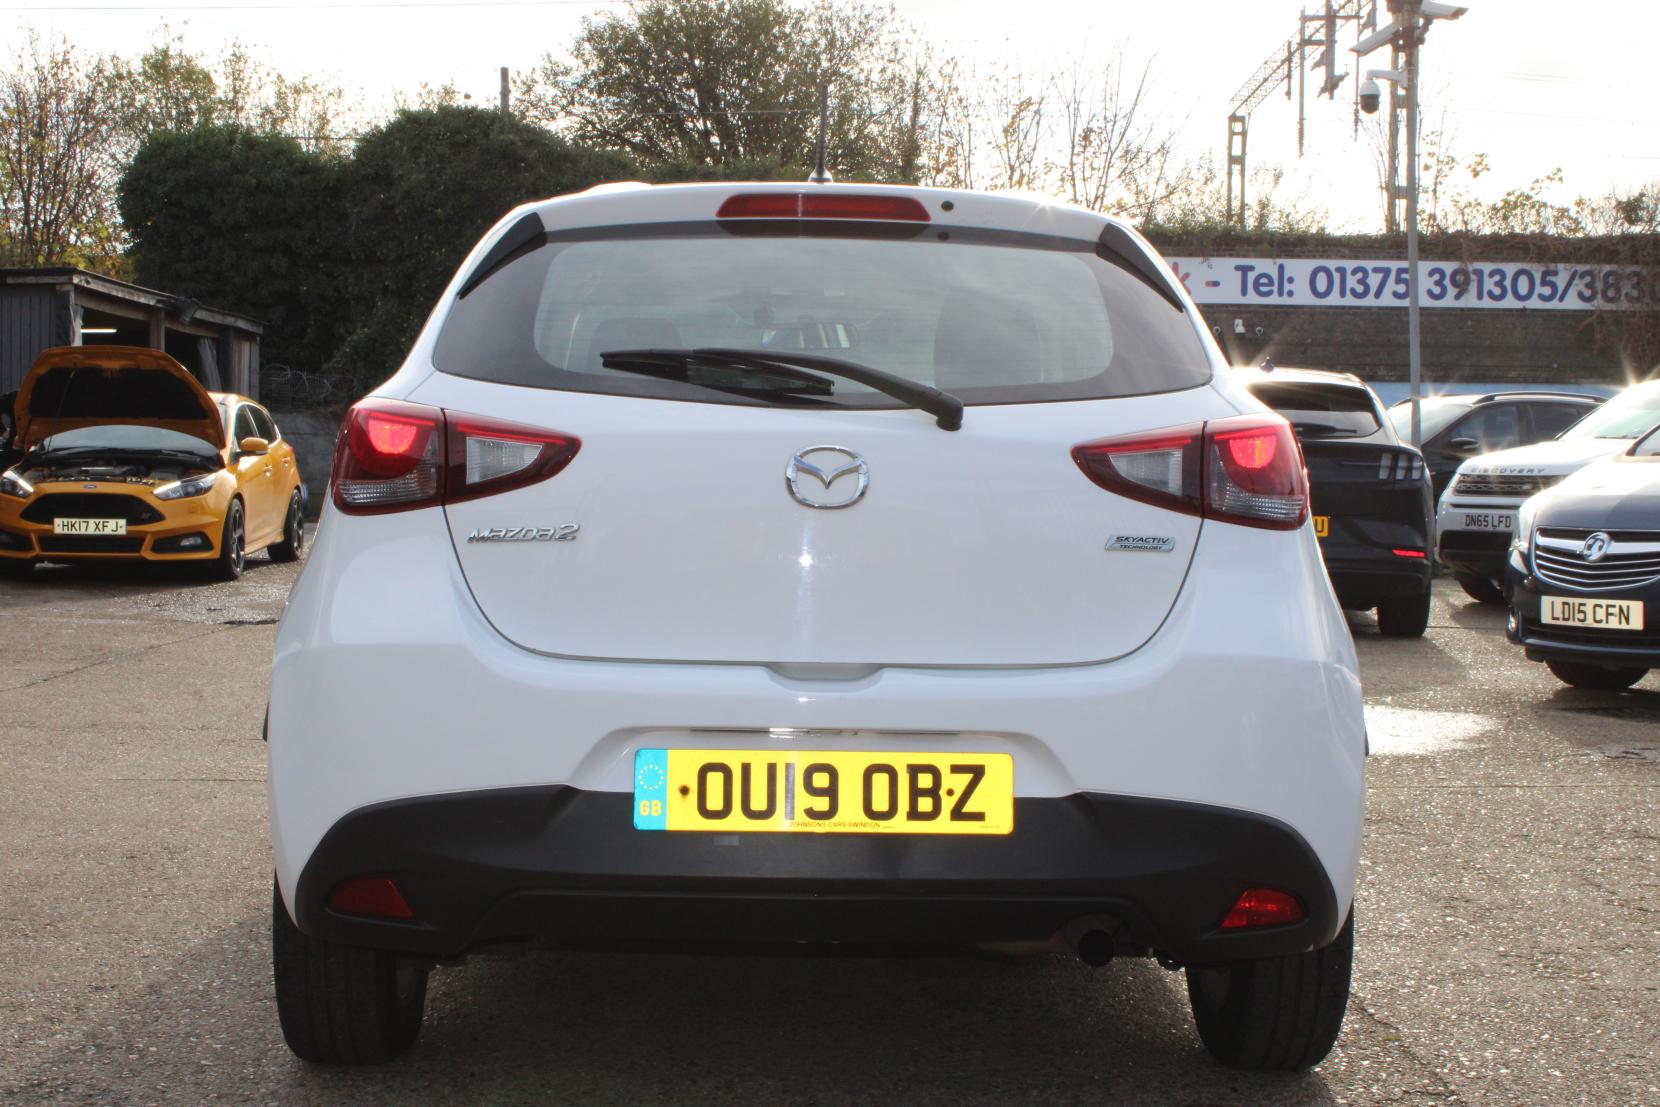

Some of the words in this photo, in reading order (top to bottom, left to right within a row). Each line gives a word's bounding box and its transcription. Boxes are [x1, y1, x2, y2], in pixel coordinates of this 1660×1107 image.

[1233, 263, 1295, 298] Tel:
[1309, 265, 1410, 300] 01375
[1426, 267, 1660, 304] 391305/383
[61, 520, 90, 532] HK17
[94, 521, 119, 533] XFJ
[1465, 514, 1489, 527] DN65
[1491, 515, 1512, 528] LFD
[1115, 535, 1170, 544] SKYACTIV
[1551, 601, 1587, 623] LD15
[1592, 603, 1630, 625] CFN
[697, 762, 839, 821] OU19
[862, 763, 986, 822] OBZ
[639, 800, 662, 816] GB
